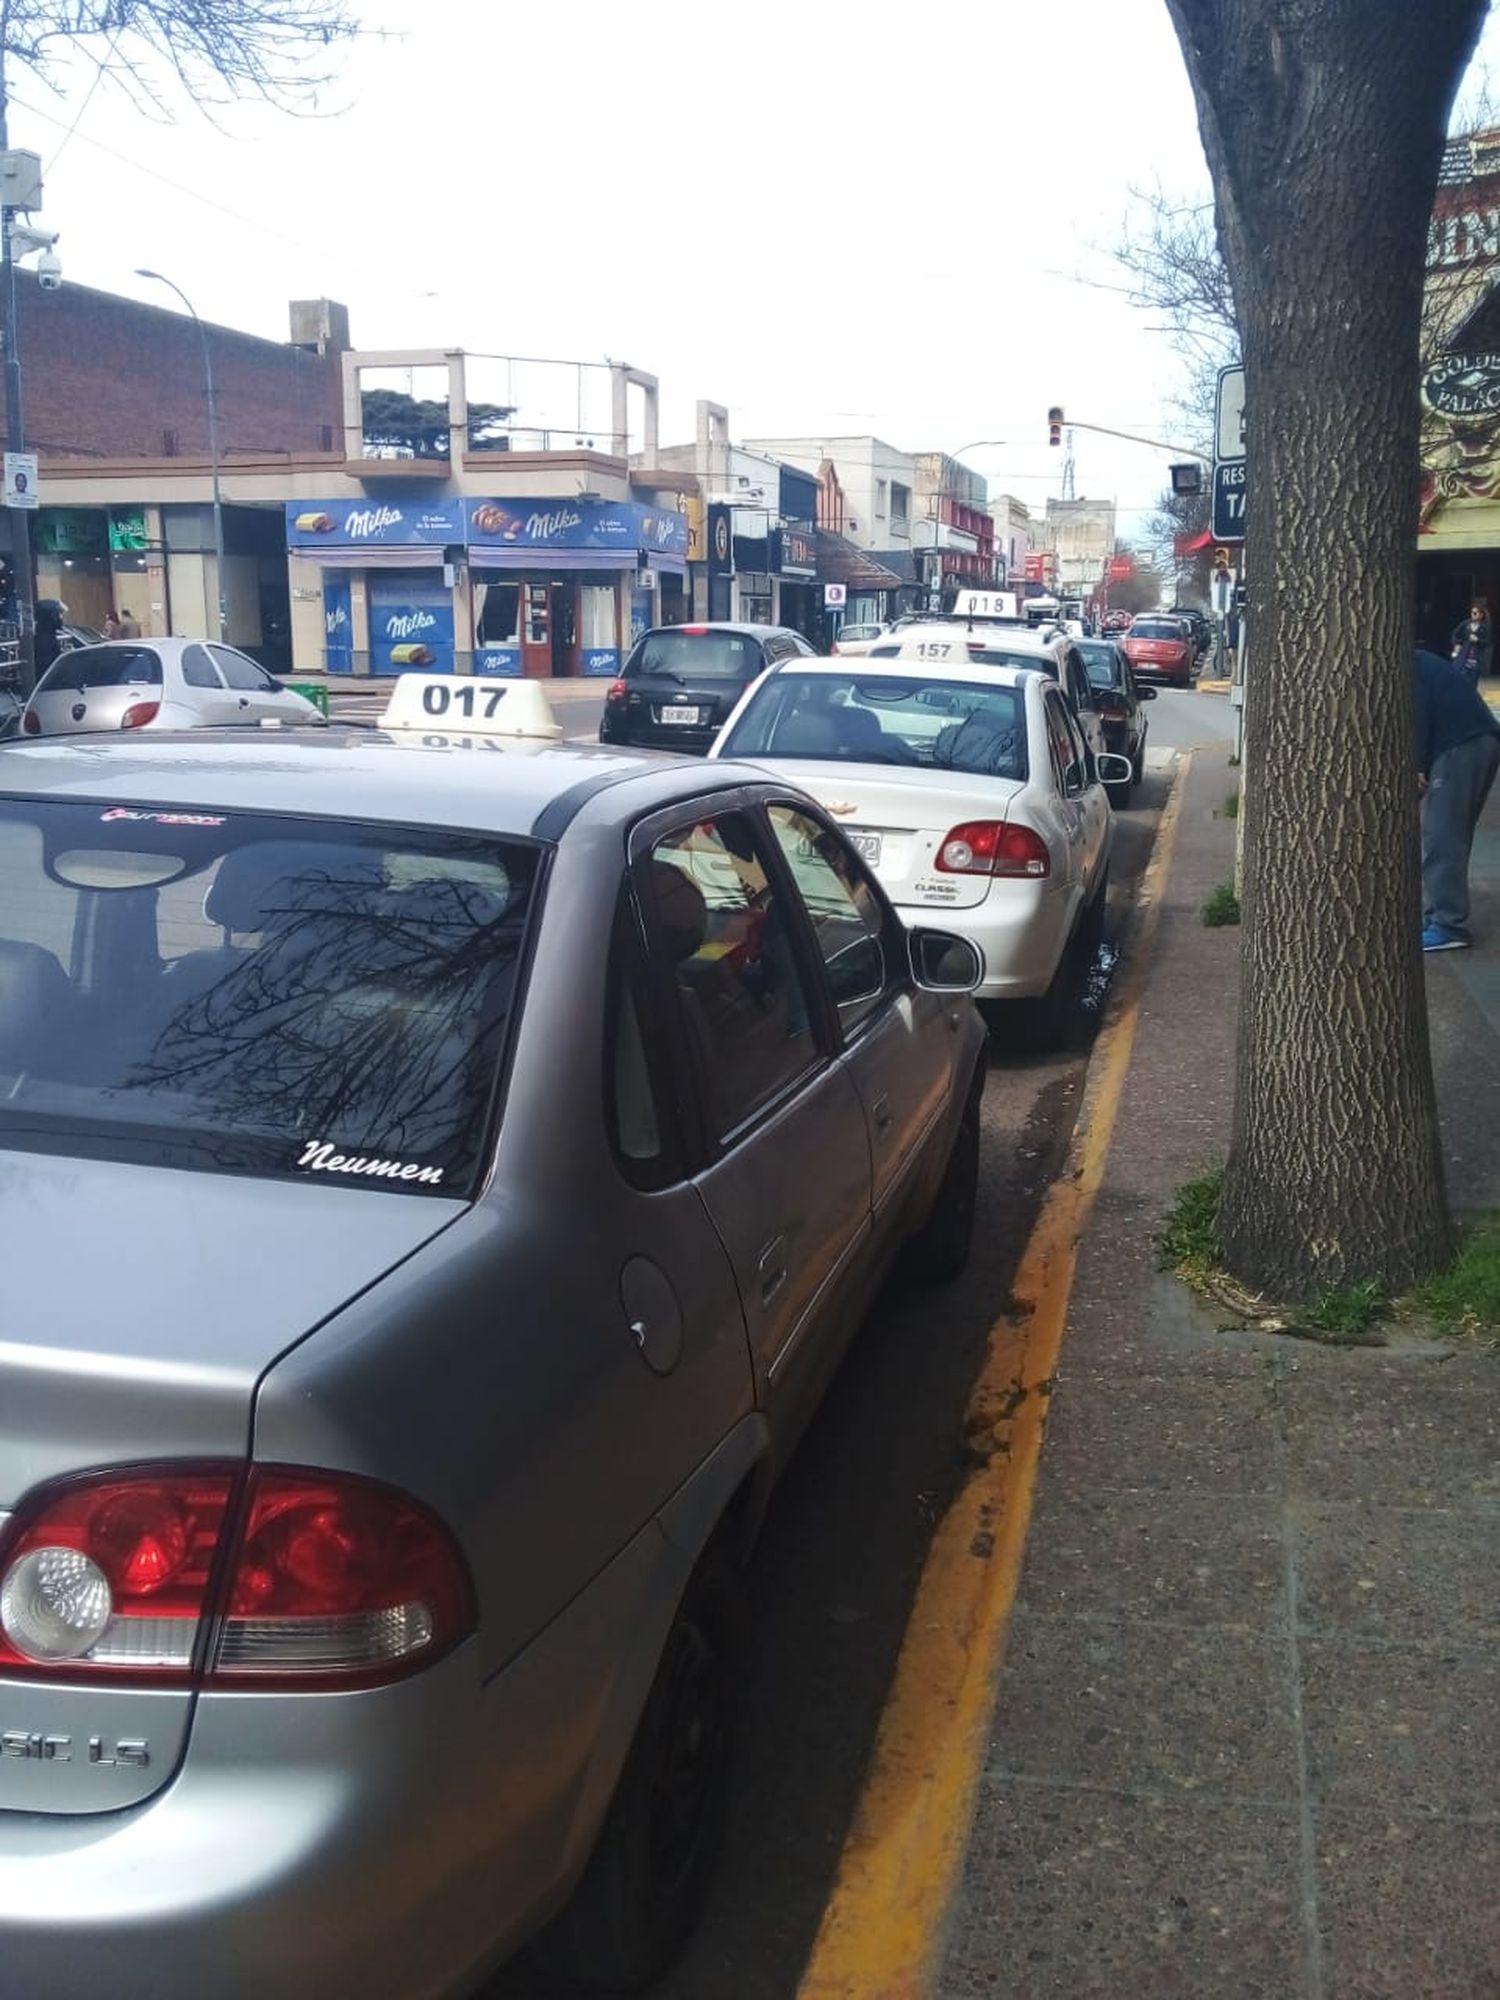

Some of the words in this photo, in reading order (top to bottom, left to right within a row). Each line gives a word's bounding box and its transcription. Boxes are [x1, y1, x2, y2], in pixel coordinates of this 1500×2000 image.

[1222, 467, 1246, 485] RES
[345, 505, 402, 538] Milka
[525, 509, 581, 539] Milka
[387, 611, 437, 638] Milka
[917, 643, 951, 657] 157
[422, 685, 508, 718] 017
[297, 1140, 444, 1184] Neumen
[89, 1737, 149, 1767] LS
